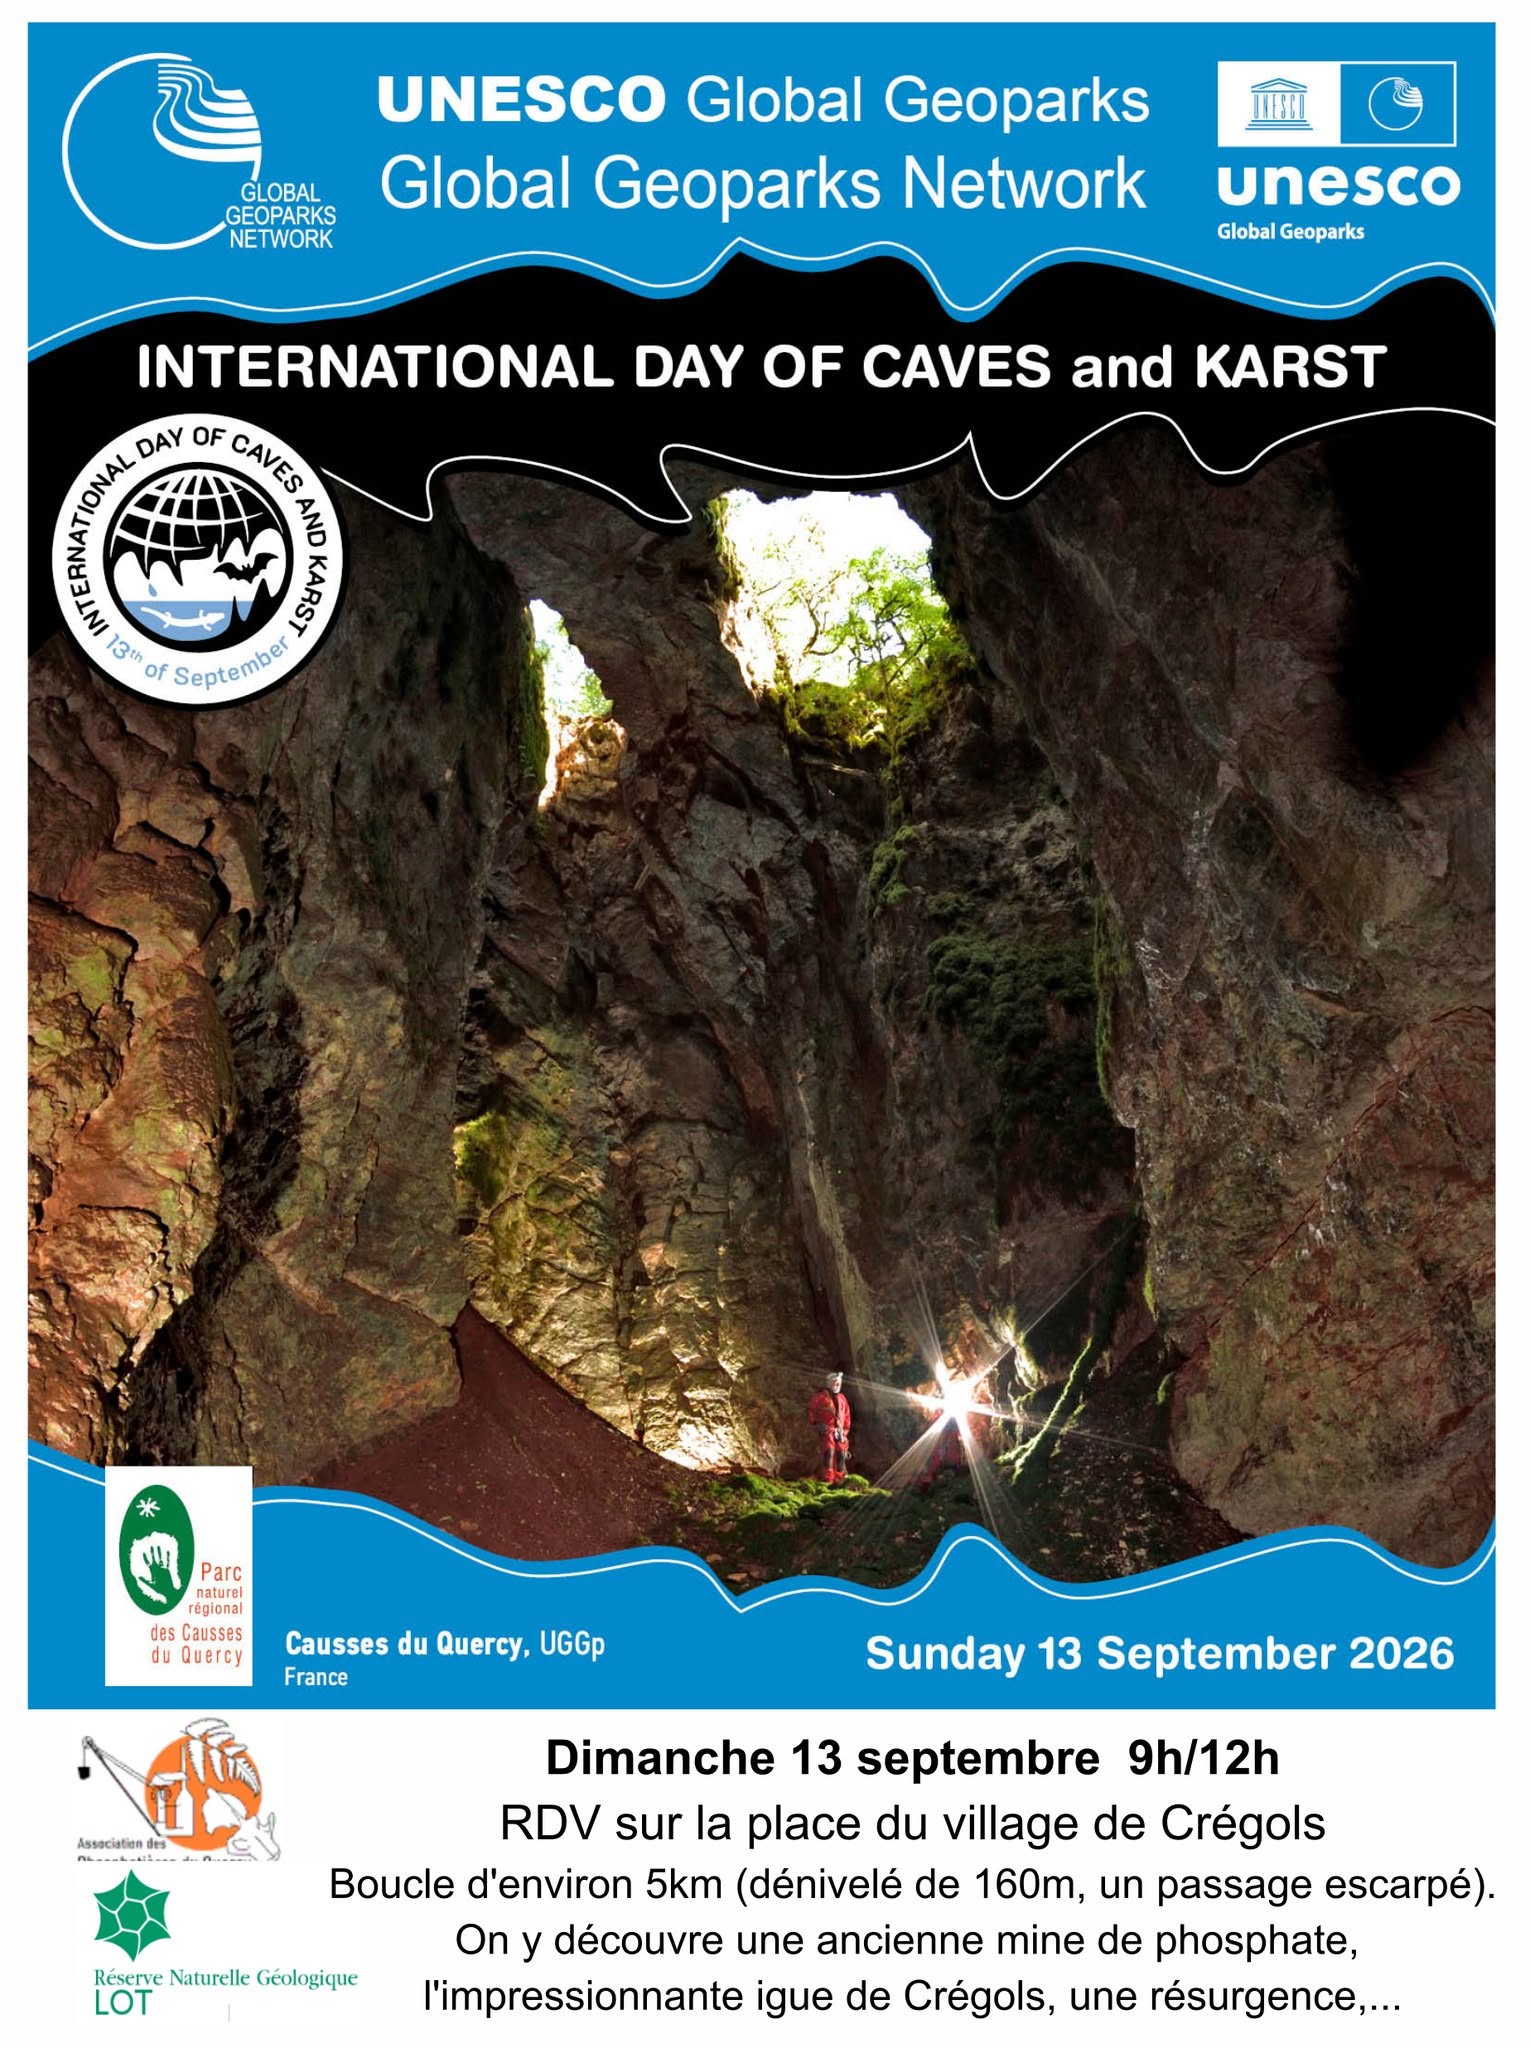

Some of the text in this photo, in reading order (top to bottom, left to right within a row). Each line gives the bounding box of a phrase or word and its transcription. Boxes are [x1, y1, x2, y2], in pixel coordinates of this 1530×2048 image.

[378, 74, 1150, 134] UNESCO Global Geoparks
[1253, 93, 1305, 120] UNESCO
[240, 182, 321, 203] GLOBAL
[381, 153, 1147, 224] Global Geoparks Network
[1217, 165, 1461, 207] unesco
[225, 205, 337, 226] GEOPARKS
[230, 228, 333, 249] NETWORK
[1217, 222, 1365, 244] Global Geoparks
[139, 343, 1388, 389] INTERNATIONAL DAY OF CAVES and KARST
[67, 426, 328, 638] INTERNATIONAL DAY OF CAVES AND KARST
[144, 664, 169, 681] of
[174, 635, 290, 690] September
[201, 1561, 242, 1582] Parc
[196, 1586, 243, 1599] naturel
[189, 1602, 243, 1617] régional
[150, 1623, 243, 1642] des Causses
[285, 1630, 605, 1662] Causses du Quercy, UGGp
[151, 1645, 242, 1667] du Quercy
[866, 1635, 1455, 1679] Sunday 13 September 2026
[284, 1666, 348, 1686] France
[547, 1738, 1279, 1785] Dimanche 13 septembre 9h/12h
[502, 1803, 1326, 1851] RDV sur la place du village de Crégols
[77, 1837, 167, 1850] Association des
[331, 1867, 1495, 1908] Boucle d'environ 5km (dénivelé de 160m, un passage escarpé).
[455, 1923, 1357, 1964] On y découvre une ancienne mine de phosphate,
[94, 1968, 358, 1991] Réserve Naturelle Géologique
[95, 1988, 154, 2016] LOT
[425, 1978, 1400, 2020] l'impressionnante igue de Crégols, une résurgence,...
